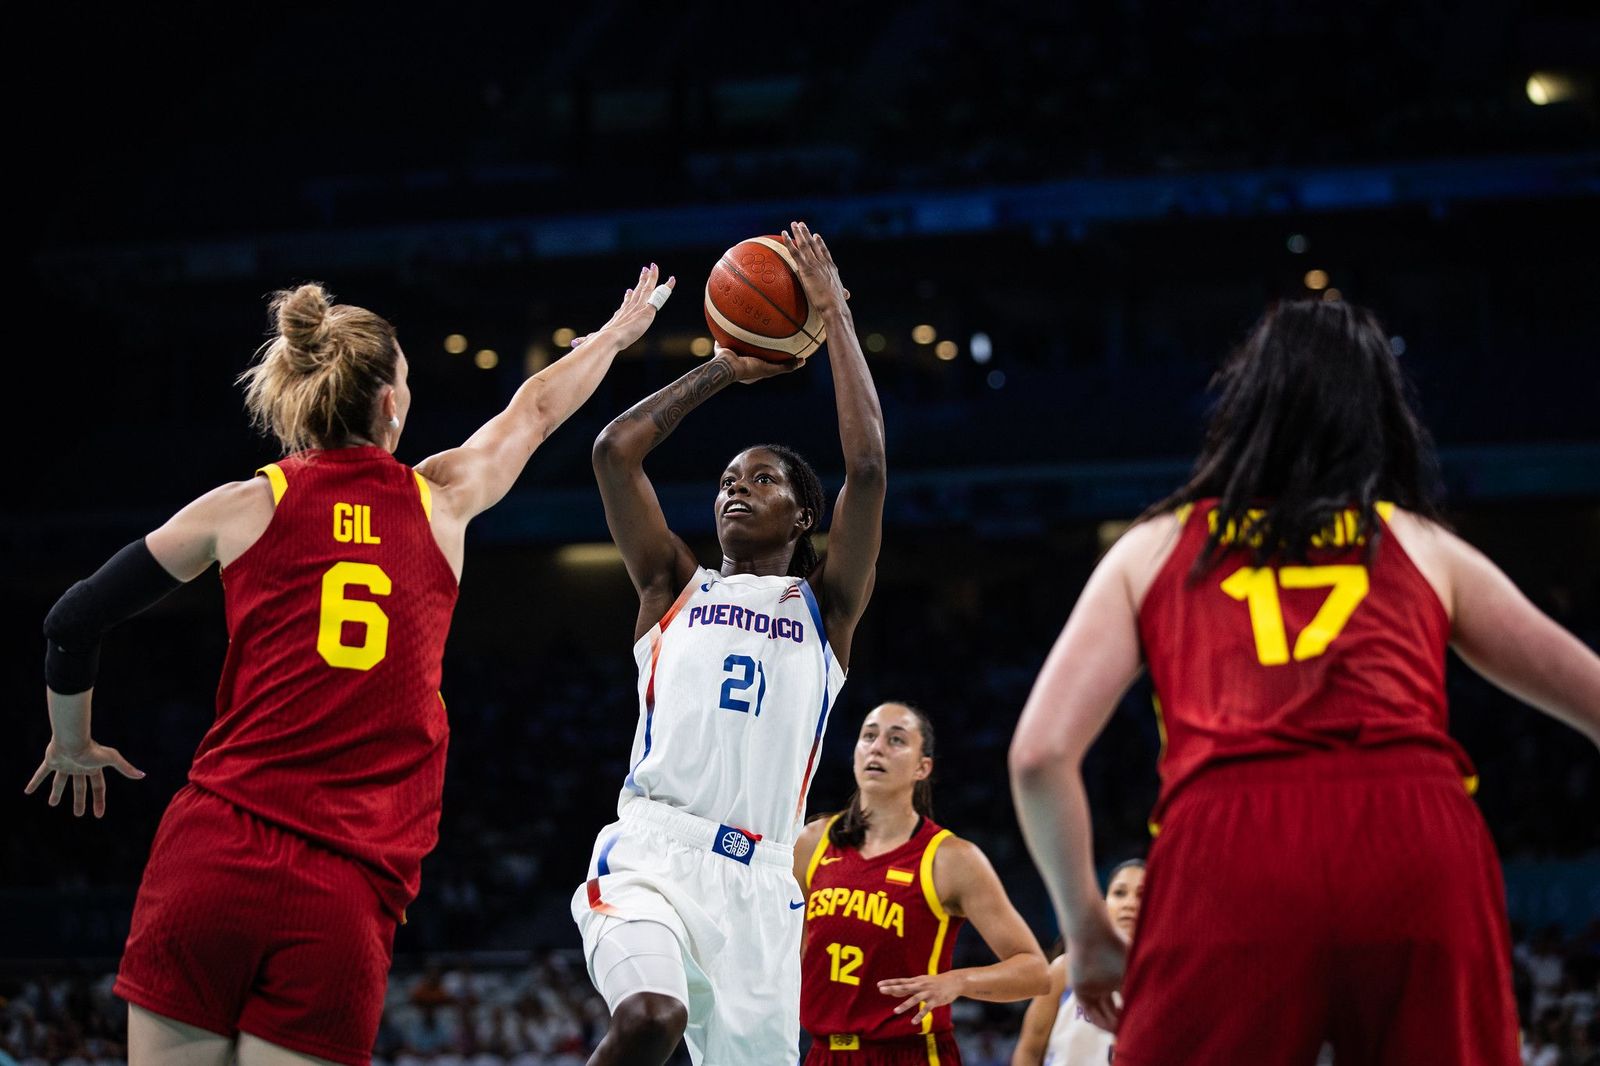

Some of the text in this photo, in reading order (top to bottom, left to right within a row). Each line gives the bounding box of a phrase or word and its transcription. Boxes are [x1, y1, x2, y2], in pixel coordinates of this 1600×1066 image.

[333, 502, 381, 544] GIL
[317, 561, 392, 671] 6
[688, 604, 804, 643] PUERTO ICO
[1220, 565, 1369, 666] 17
[807, 887, 904, 938] ESPAÑA
[826, 942, 864, 986] 12
